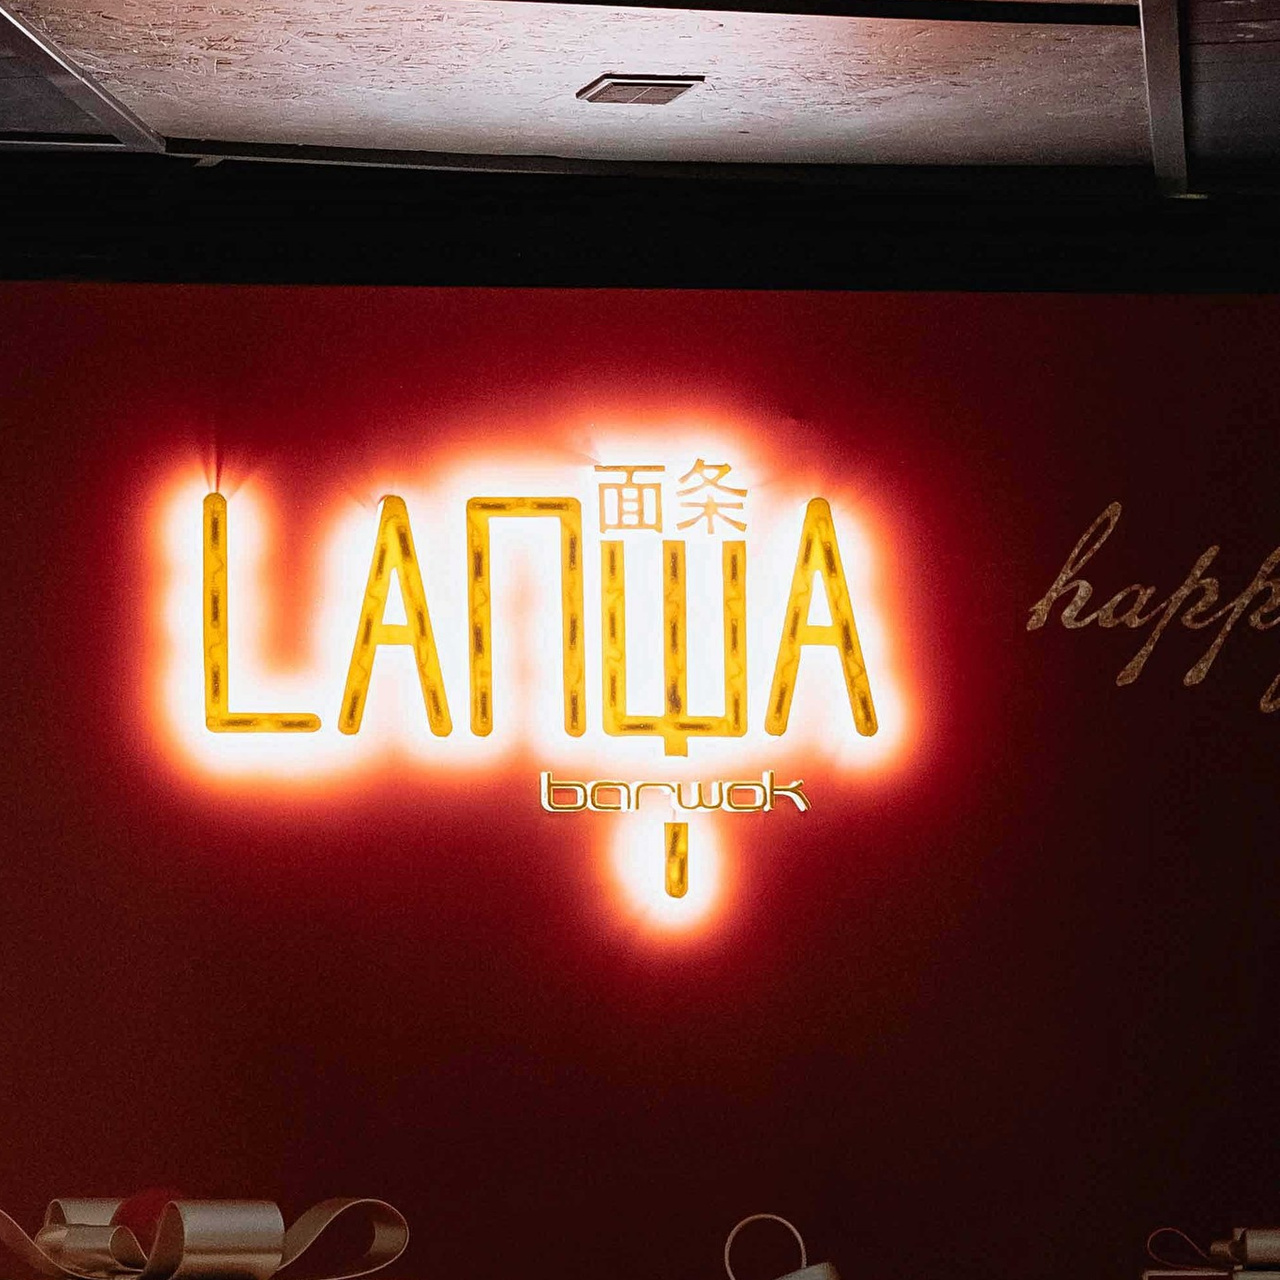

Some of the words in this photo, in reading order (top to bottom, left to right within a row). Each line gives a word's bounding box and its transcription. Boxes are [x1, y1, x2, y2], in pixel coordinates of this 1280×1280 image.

[594, 458, 748, 535] 面条
[1026, 501, 1280, 713] happ
[539, 770, 813, 814] barwok
